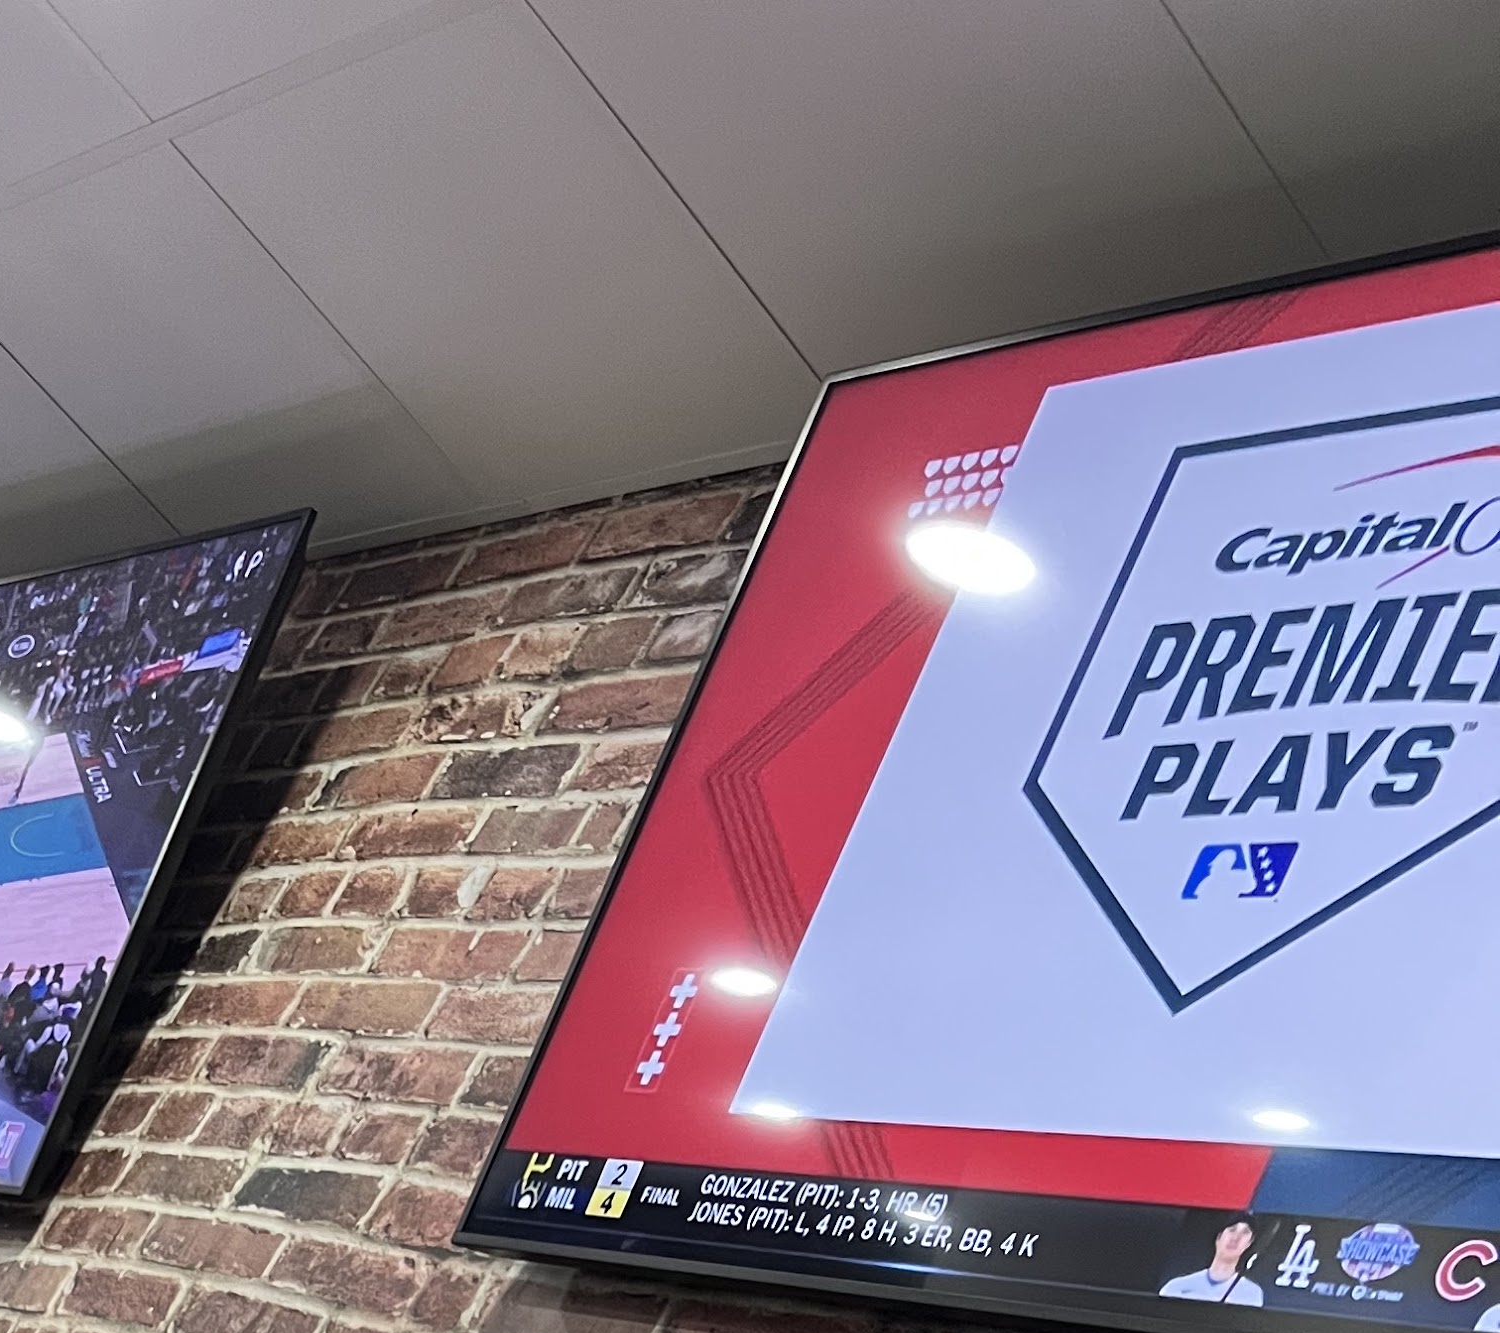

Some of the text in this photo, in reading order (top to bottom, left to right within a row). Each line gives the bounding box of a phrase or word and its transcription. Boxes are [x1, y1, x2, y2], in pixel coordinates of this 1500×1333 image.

[1102, 588, 1500, 740] PREMIE
[1119, 724, 1457, 822] PLAYS
[556, 1159, 628, 1186] PIT 2
[700, 1172, 950, 1220] GONZALEZ (PIT): 1-3, HR (5)
[545, 1185, 681, 1214] MIL 4 FINAL
[687, 1201, 746, 1230] JONES
[745, 1206, 795, 1236] (PIT):
[815, 1216, 829, 1237] 4
[832, 1217, 856, 1242] IP,
[859, 1219, 877, 1240] 8
[877, 1221, 900, 1247] H,
[902, 1223, 918, 1246] 3
[918, 1225, 953, 1254] ER,
[956, 1229, 995, 1257] BB,
[1000, 1231, 1016, 1254] 4
[1016, 1233, 1040, 1258] K
[1336, 1238, 1421, 1266] SHOWCASE
